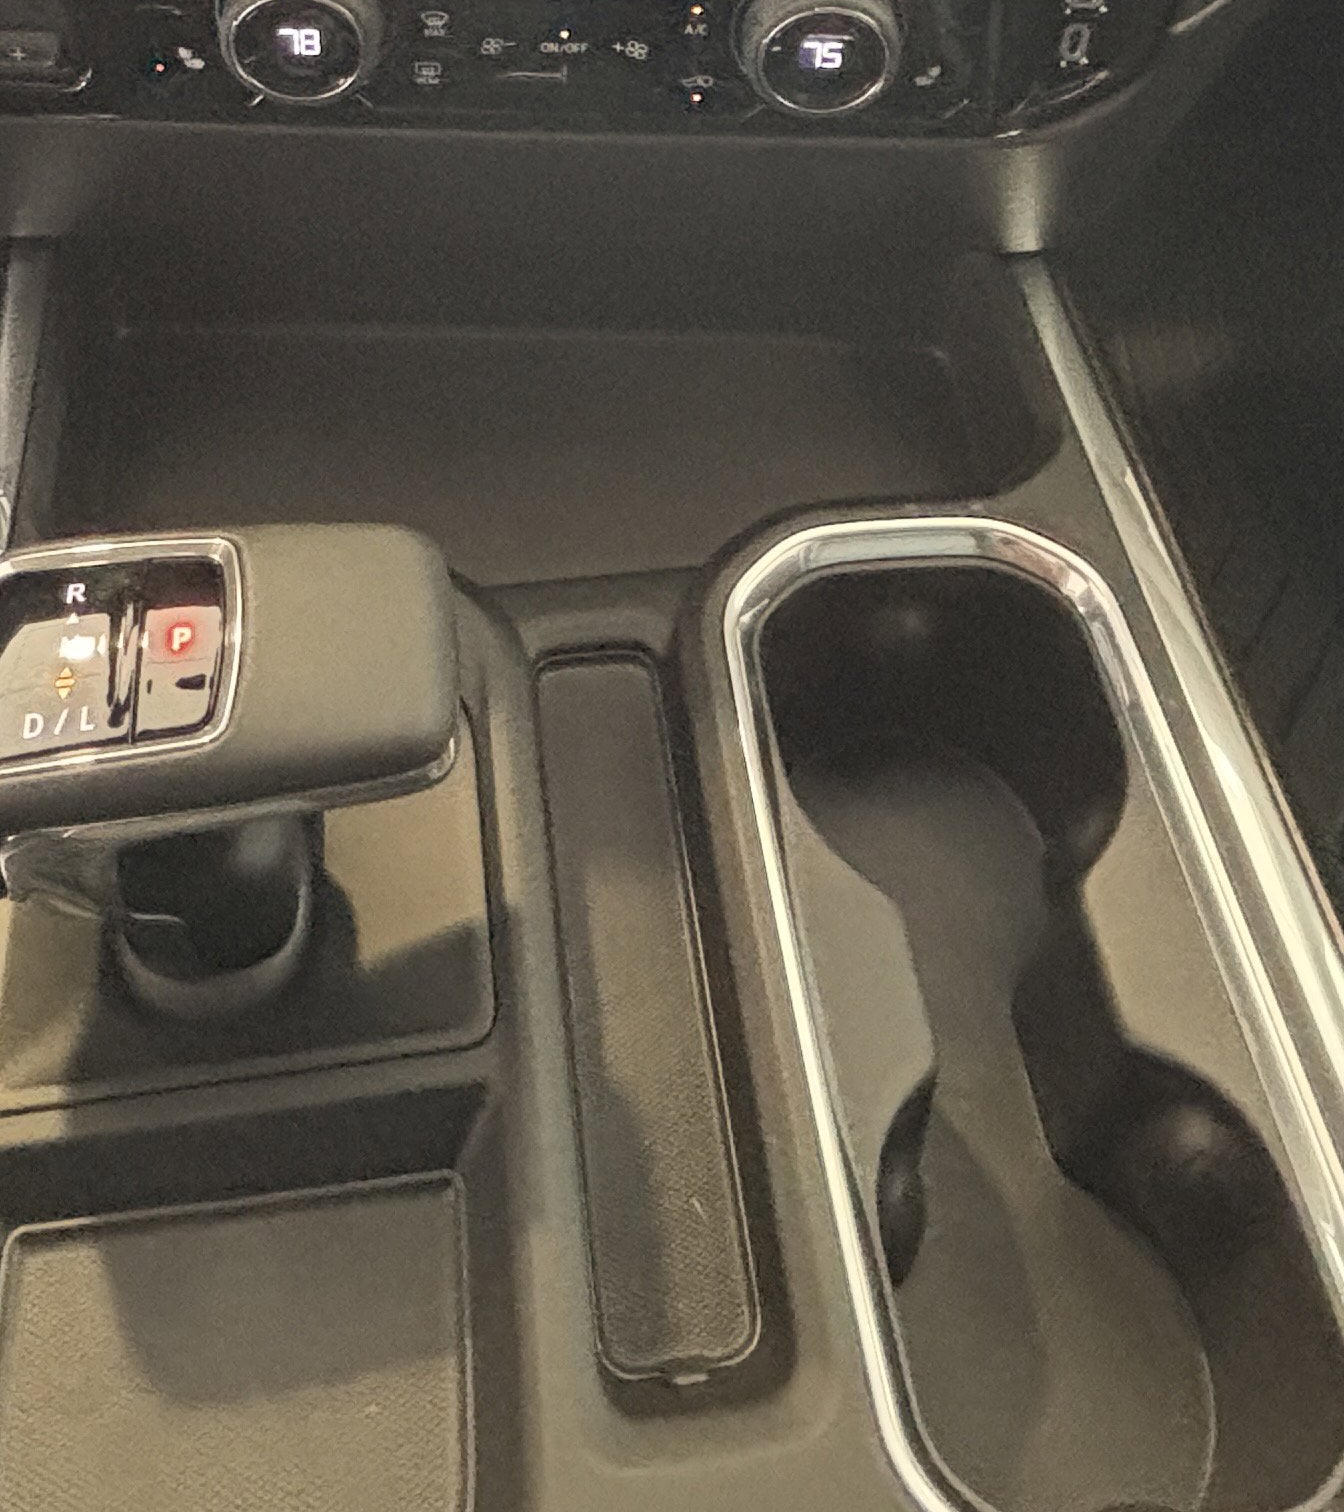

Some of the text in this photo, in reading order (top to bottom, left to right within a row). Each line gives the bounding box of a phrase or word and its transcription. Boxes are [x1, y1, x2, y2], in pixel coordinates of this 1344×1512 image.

[278, 28, 321, 56] 78
[540, 42, 588, 54] ON/OFF
[803, 42, 843, 70] 75
[66, 583, 87, 604] R
[172, 626, 193, 651] P
